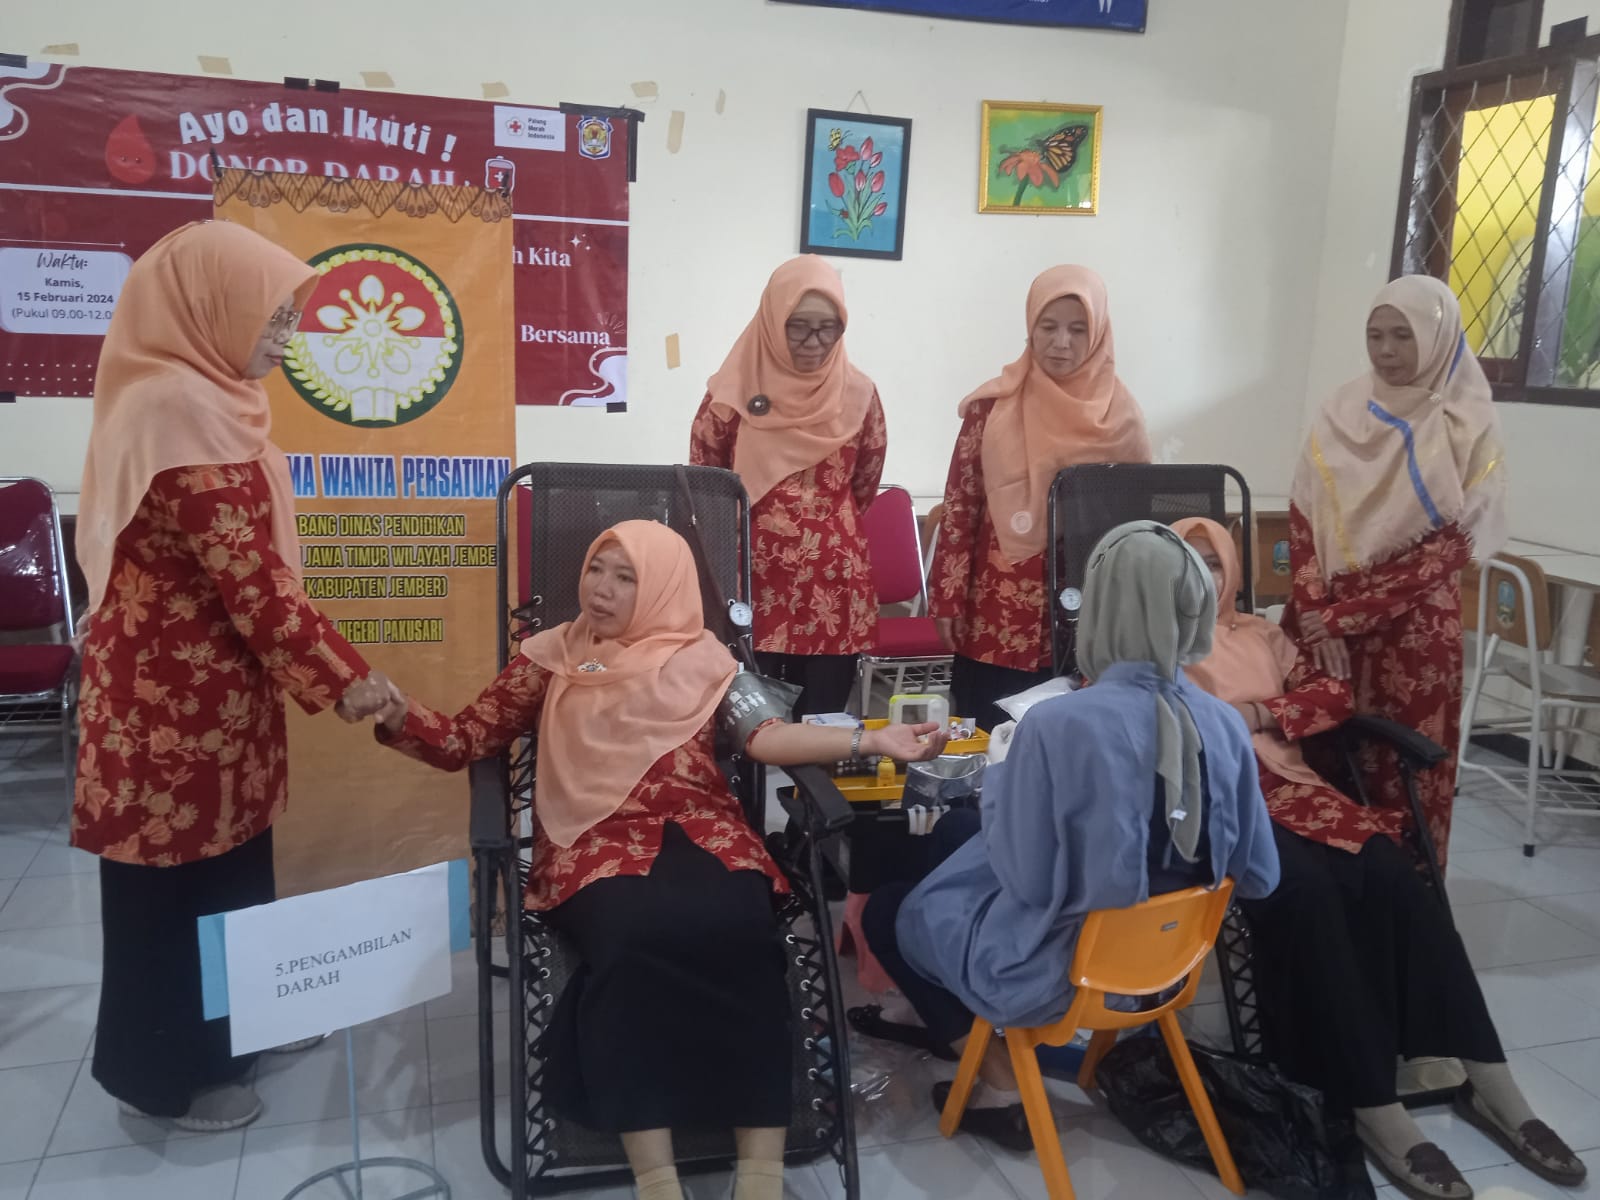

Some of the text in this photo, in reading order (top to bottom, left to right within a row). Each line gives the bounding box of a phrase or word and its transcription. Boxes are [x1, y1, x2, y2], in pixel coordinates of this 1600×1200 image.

[179, 102, 457, 162] Ayo dan Ikuti !
[528, 247, 572, 267] Kita
[45, 277, 84, 288] Kamis,
[17, 292, 114, 304] 15 Februari 2024
[12, 308, 114, 320] (Pukul 09.00-12.0
[521, 324, 611, 345] Bersama
[285, 455, 510, 498] MA WANITA PERSATUAN
[296, 514, 465, 537] BANG DINAS PENDIDIKAN
[304, 545, 498, 567] JAWA TIMUR WILAYAH JEMBE
[389, 576, 448, 598] JEMBER)
[338, 619, 443, 643] NEGERI PAKUSARI
[275, 928, 412, 977] 5.PENGAMBILAN
[276, 970, 341, 999] DARAH
